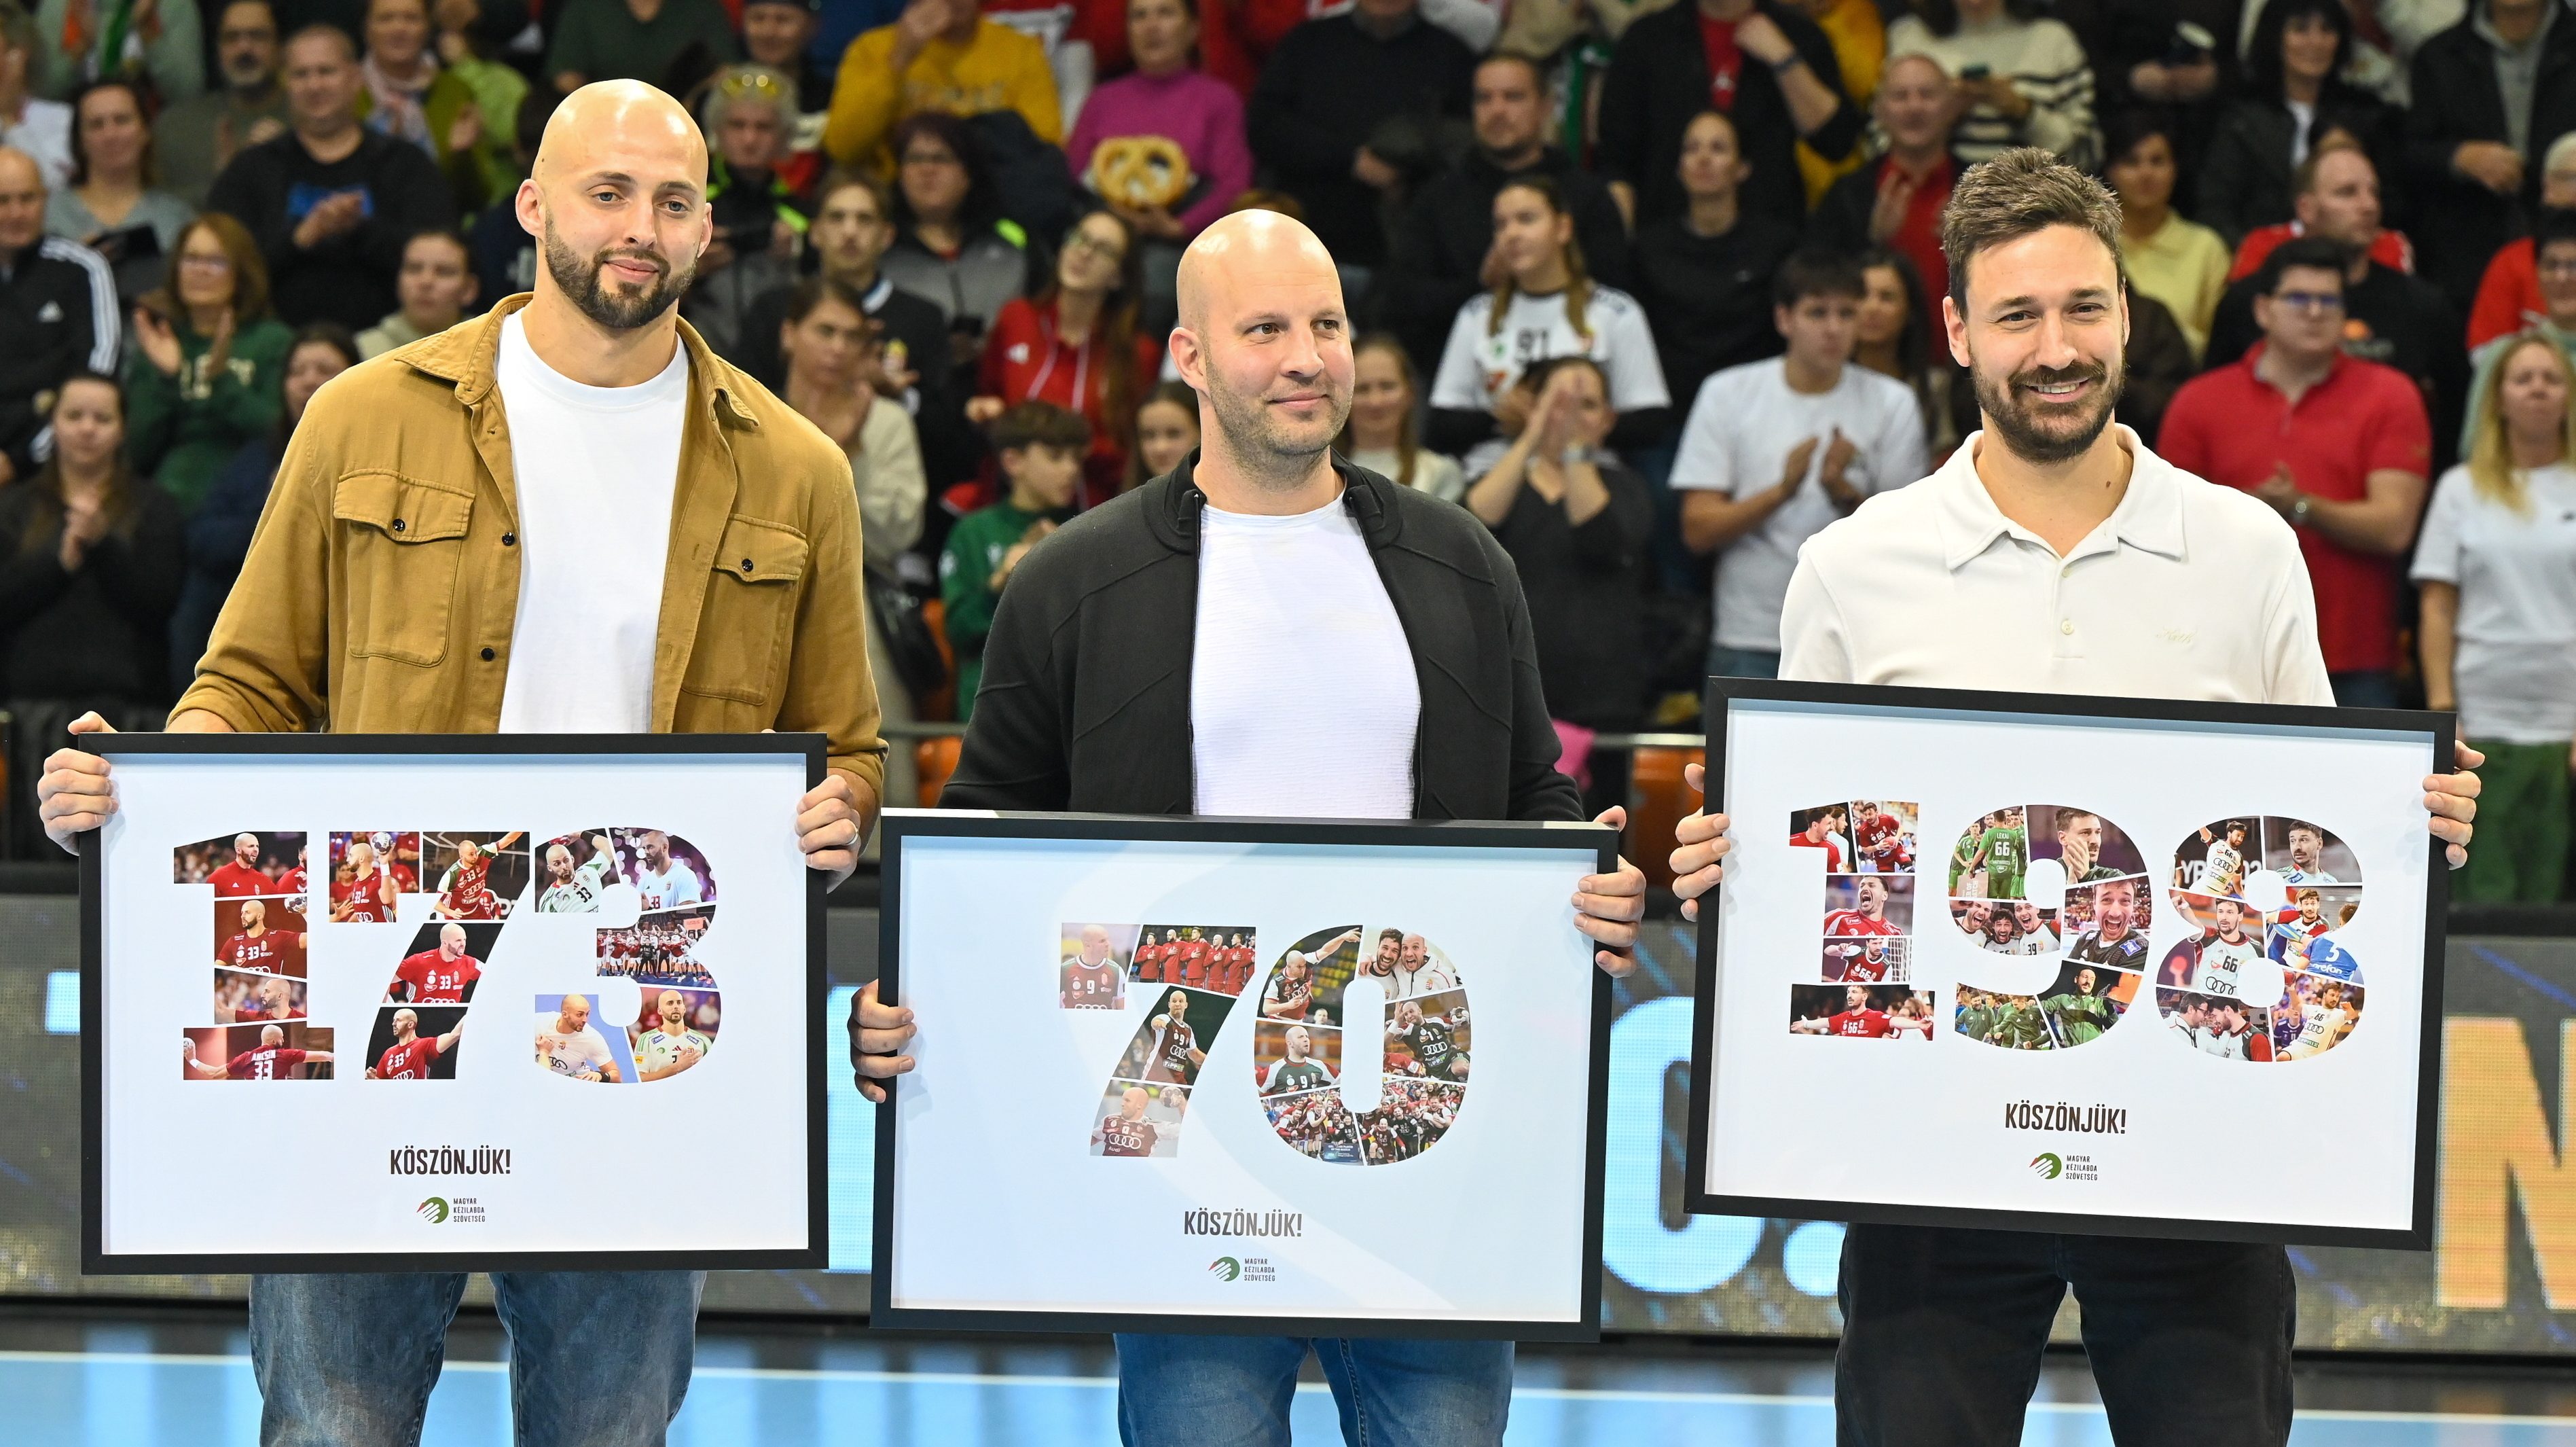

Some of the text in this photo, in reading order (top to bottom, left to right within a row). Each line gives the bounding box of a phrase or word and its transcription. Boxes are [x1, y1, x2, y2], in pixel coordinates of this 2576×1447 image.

[1995, 842, 2010, 856] 66
[577, 887, 593, 904] 33
[1789, 802, 2365, 1062] 198
[173, 827, 721, 1084] 173
[247, 946, 259, 961] 33
[2222, 955, 2238, 973] 66
[439, 975, 452, 990] 33
[1087, 980, 1095, 995] 9
[1847, 1022, 1858, 1034] 66
[1057, 923, 1473, 1167] 70
[1300, 1075, 1308, 1088] 9
[2006, 1099, 2126, 1135] KÖSZÖNJÜK!
[391, 1145, 511, 1175] KÖSZÖNJÜK!
[2066, 1163, 2097, 1172] KÉZILABDA
[2066, 1172, 2098, 1181] SZÖVETSÉG
[453, 1206, 485, 1214] KÉZILABDA
[453, 1215, 486, 1223] SZÖVETSÉG
[1184, 1207, 1302, 1237] KÖSZÖNJÜK!
